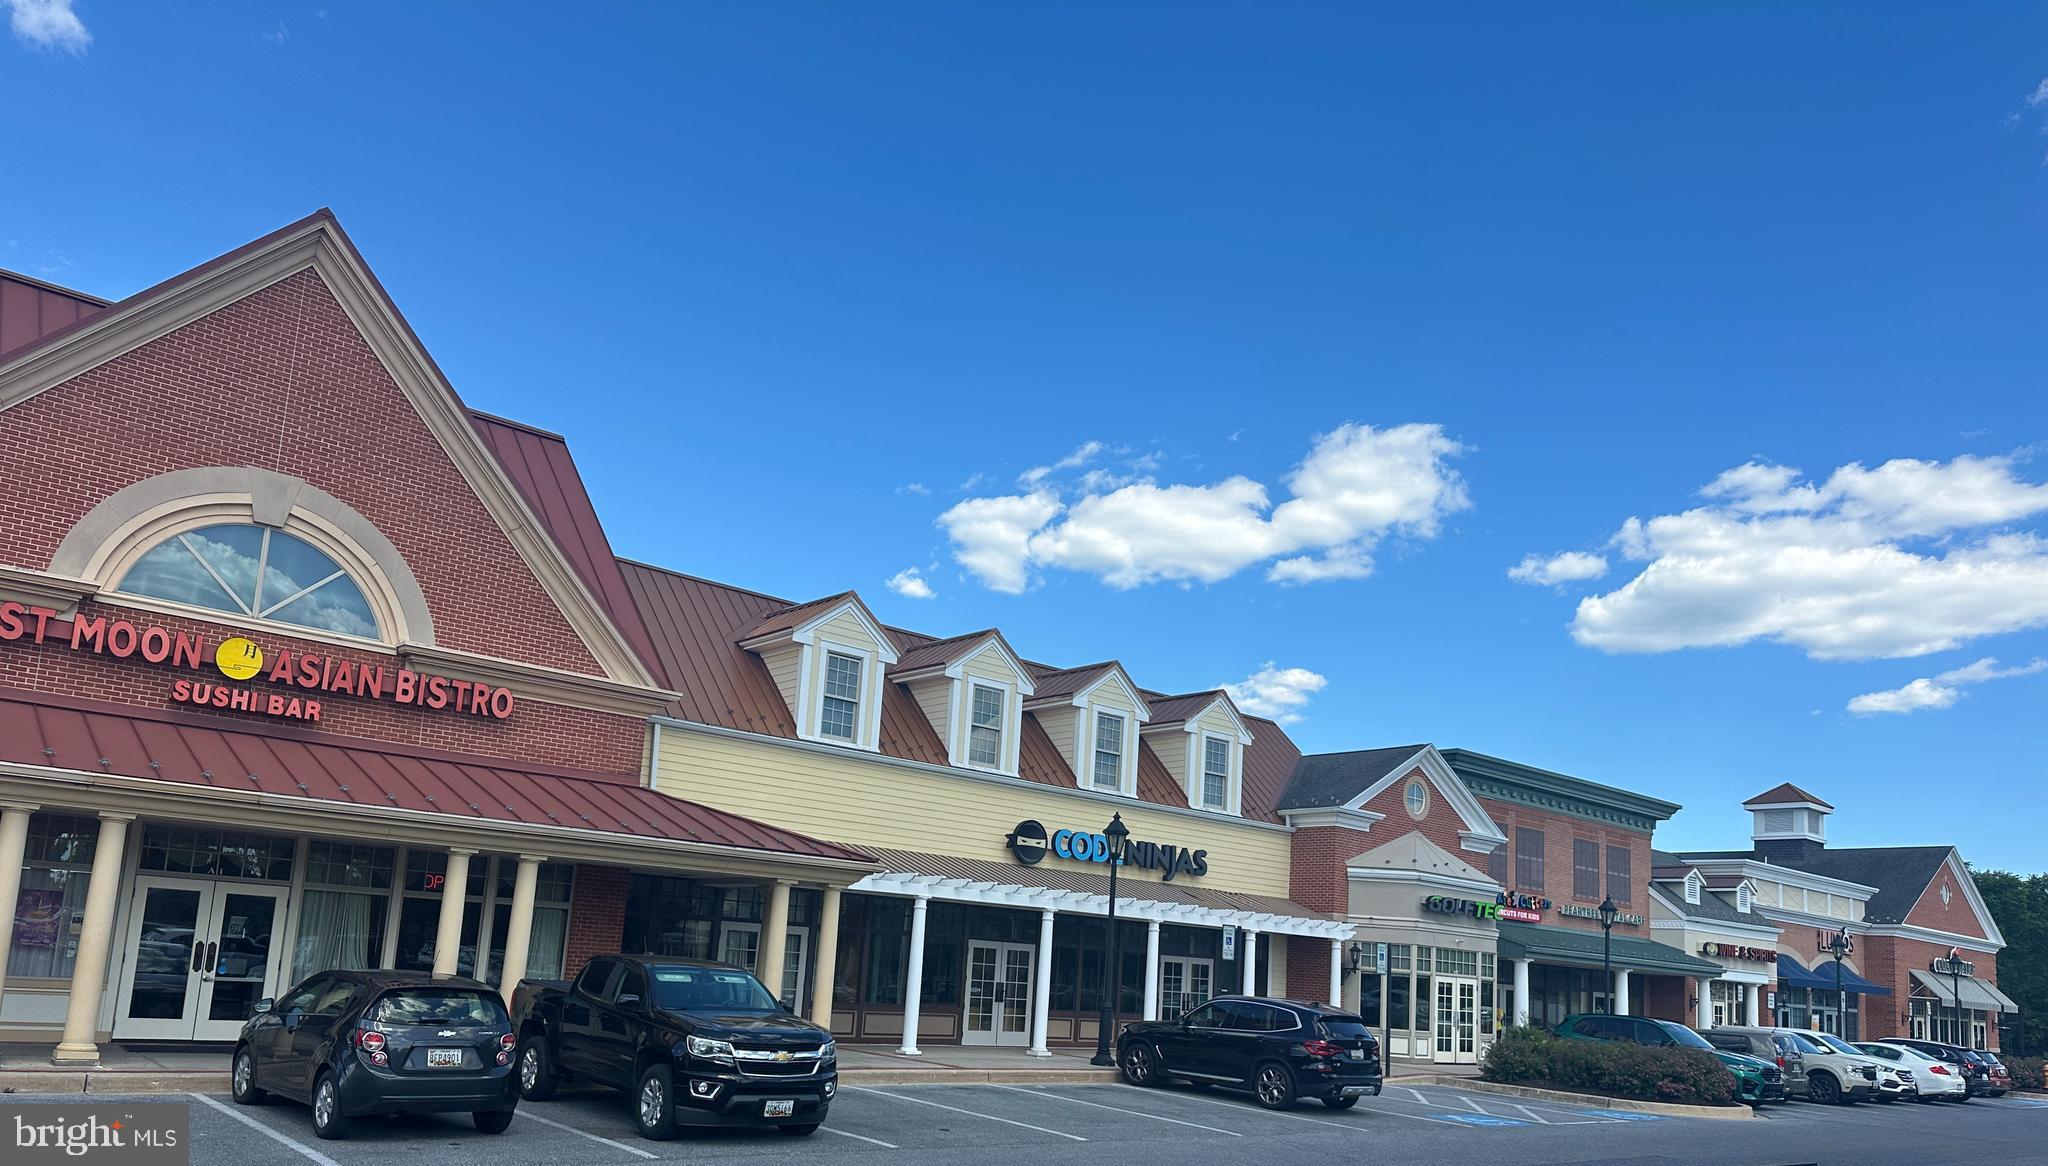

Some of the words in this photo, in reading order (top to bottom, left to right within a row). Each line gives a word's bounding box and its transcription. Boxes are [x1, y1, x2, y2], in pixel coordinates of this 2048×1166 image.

[71, 613, 205, 670] MOON
[268, 649, 384, 699] ASIAN
[394, 669, 515, 719] BISTRO
[172, 679, 258, 712] SUSHI
[267, 694, 322, 722] BAR
[1051, 828, 1124, 866] COD
[1122, 839, 1208, 881] NINJAS
[425, 874, 444, 888] OP
[1425, 894, 1505, 922] GOLFTEC
[1517, 911, 1528, 919] FOR
[1528, 912, 1541, 921] KIDS
[1717, 943, 1739, 958] WINE
[1749, 948, 1777, 964] SPIRITS
